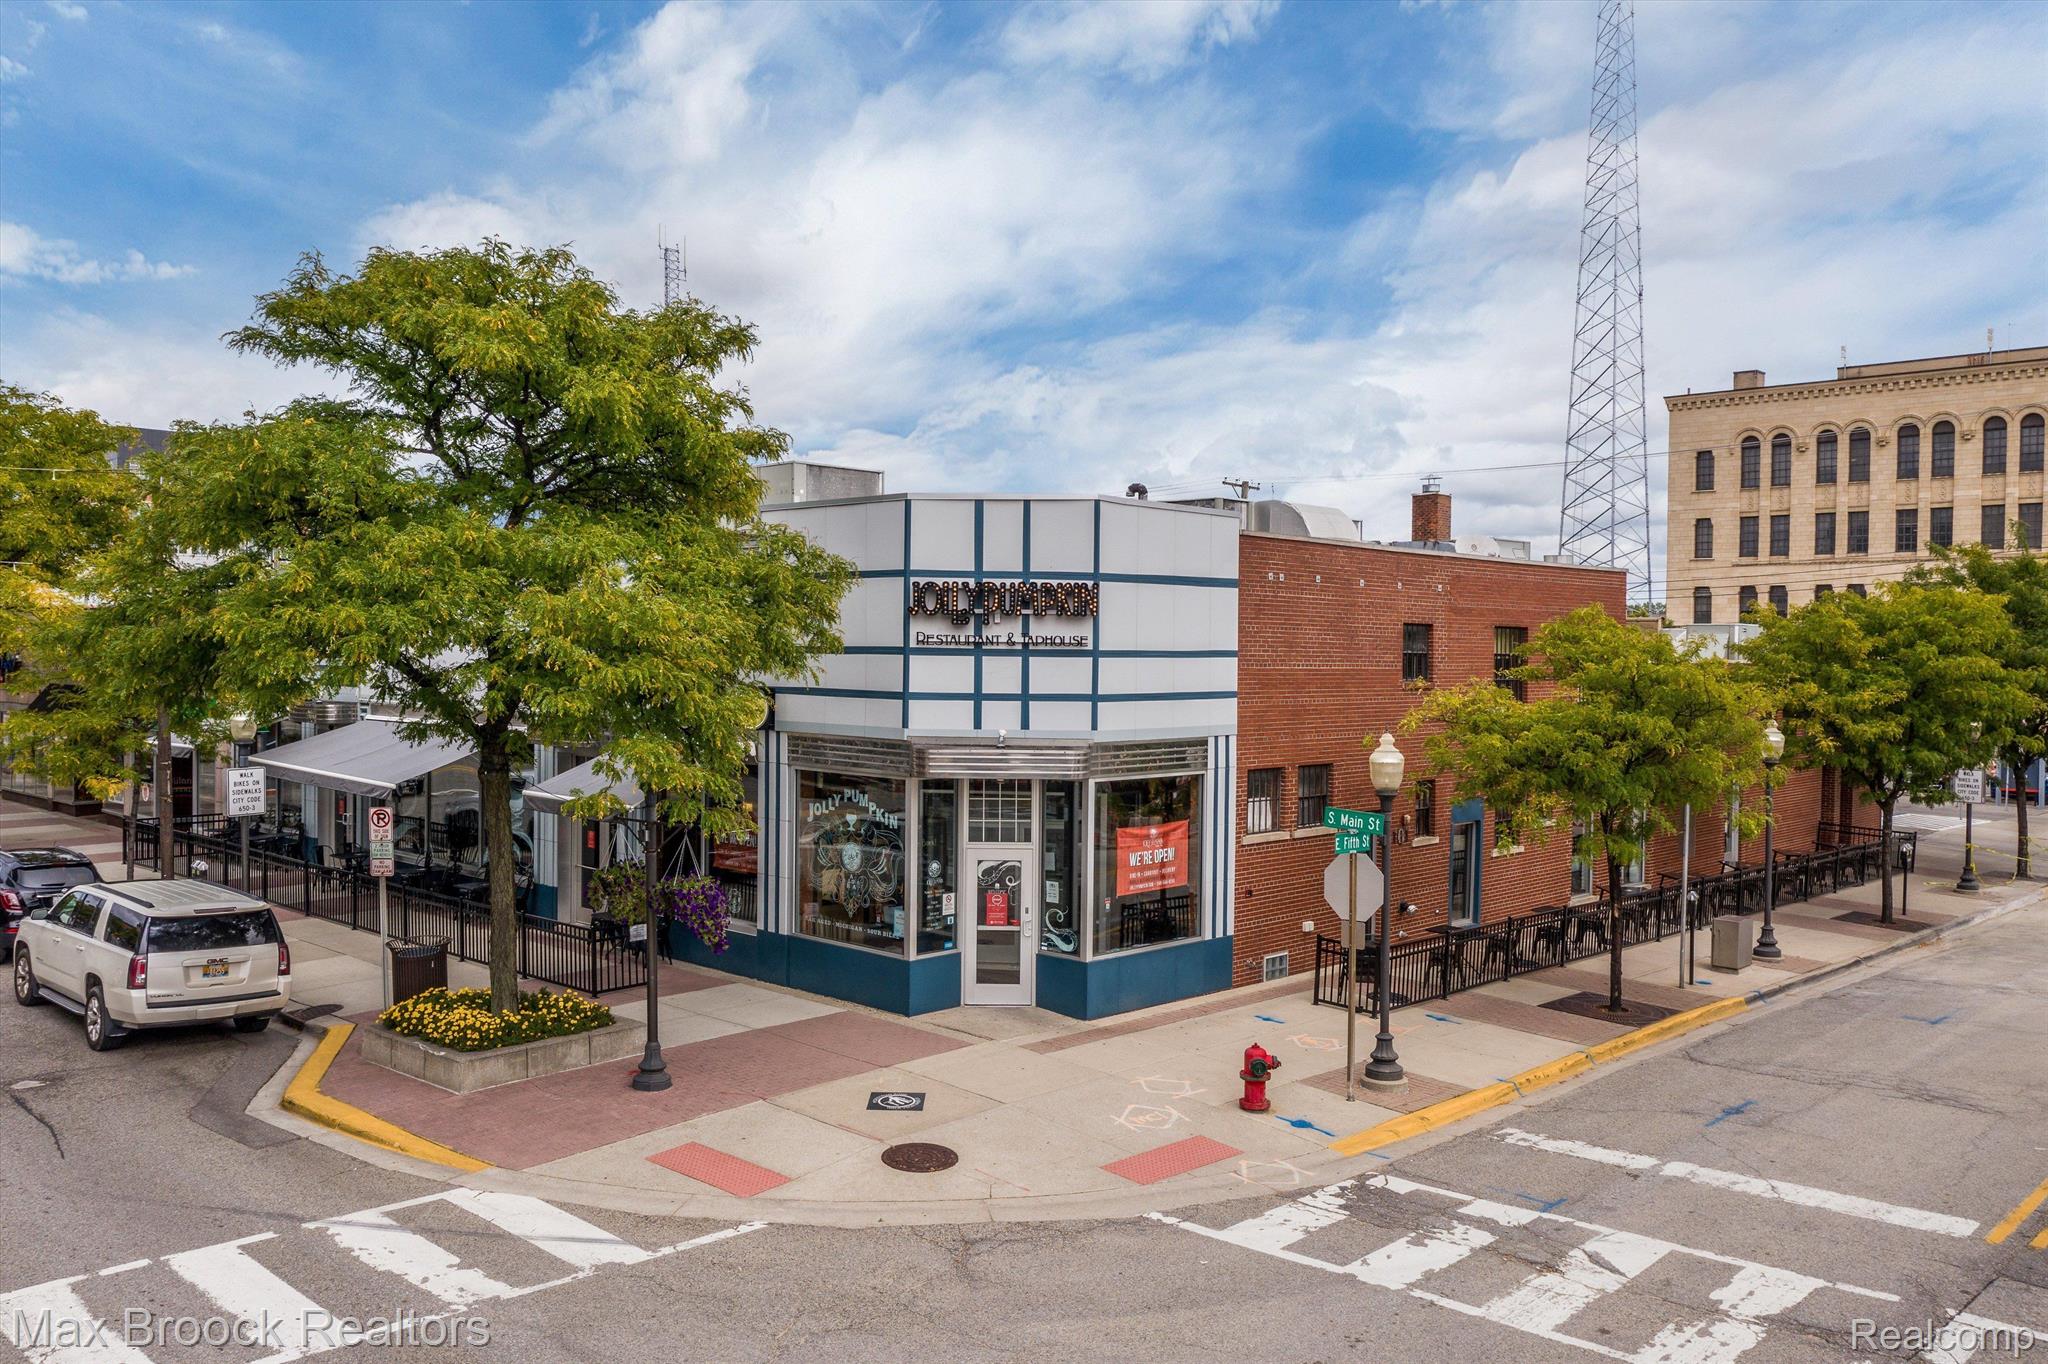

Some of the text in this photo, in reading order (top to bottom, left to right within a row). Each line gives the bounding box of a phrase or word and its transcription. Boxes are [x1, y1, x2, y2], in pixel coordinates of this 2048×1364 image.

[1006, 632, 1016, 646] &
[231, 788, 262, 796] SIDEWALKS
[807, 788, 898, 829] JOLLY PUMPKIN
[1327, 811, 1380, 831] S. Main St
[1335, 834, 1370, 851] E Fifth St
[1129, 847, 1175, 867] WE'RE OPEN!
[835, 921, 863, 932] MICHIGAN
[207, 957, 229, 965] GMC
